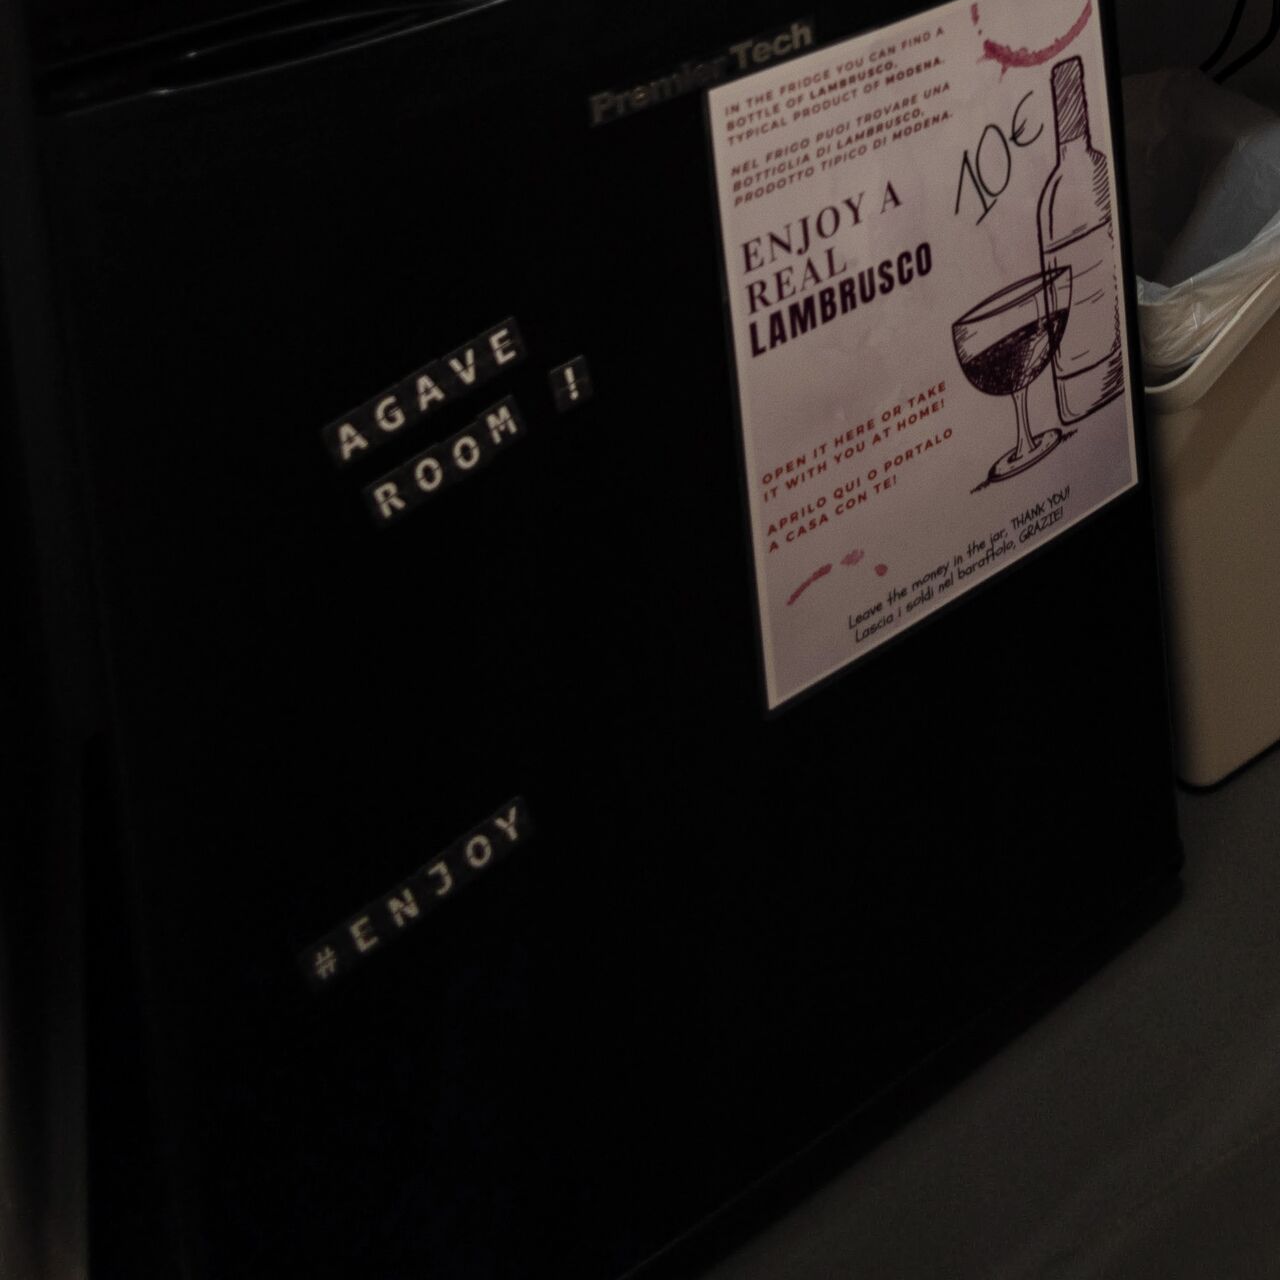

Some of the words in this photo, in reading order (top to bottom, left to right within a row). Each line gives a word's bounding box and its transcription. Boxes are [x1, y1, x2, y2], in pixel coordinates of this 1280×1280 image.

[724, 102, 740, 117] IN
[745, 90, 774, 110] THE
[836, 57, 865, 75] YOU
[868, 45, 897, 63] CAN
[901, 31, 932, 51] FIND
[935, 26, 945, 37] A
[729, 21, 812, 69] Tech
[726, 103, 780, 132] BOTTLE
[785, 95, 803, 109] OF
[727, 116, 788, 147] TYPICAL
[793, 89, 857, 122] PRODUCT
[863, 80, 881, 95] OF
[730, 157, 759, 178] NEL
[815, 122, 850, 143] PUOI
[856, 93, 919, 127] TROVARE
[923, 81, 950, 100] UNA
[815, 143, 832, 159] DI
[733, 165, 815, 208] PRODOTTO
[820, 143, 868, 172] TIPICO
[872, 136, 887, 151] DI
[741, 191, 865, 275] ENJOY
[879, 179, 903, 215] A
[745, 246, 848, 316] REAL
[748, 241, 933, 359] LAMBRUSCO
[337, 327, 517, 461] AGAVE
[761, 454, 807, 485] OPEN
[812, 443, 828, 459] IT
[833, 418, 876, 448] HERE
[880, 404, 902, 422] OR
[907, 380, 947, 408] TAKE
[373, 405, 518, 519] ROOM
[763, 486, 779, 503] IT
[784, 460, 828, 491] WITH
[833, 441, 866, 465] YOU
[871, 426, 892, 445] AT
[896, 398, 946, 432] HOME!
[766, 495, 828, 537] APRILO
[832, 477, 862, 500] QUI
[867, 468, 878, 481] O
[883, 427, 954, 473] PORTALO
[768, 540, 780, 553] A
[785, 513, 829, 543] CASA
[834, 490, 868, 517] CON
[872, 474, 898, 495] TE!
[848, 601, 883, 630] Leave
[886, 587, 908, 607] the
[911, 560, 950, 592] money
[953, 555, 964, 568] in
[966, 540, 986, 559] the
[1011, 500, 1046, 530] THANK
[1046, 485, 1071, 509] YOU!
[855, 613, 895, 644] Lascia
[905, 585, 935, 613] soldi
[938, 571, 955, 592] nel
[1018, 506, 1065, 544] GRAZIE!
[314, 805, 518, 980] #ENJOY
